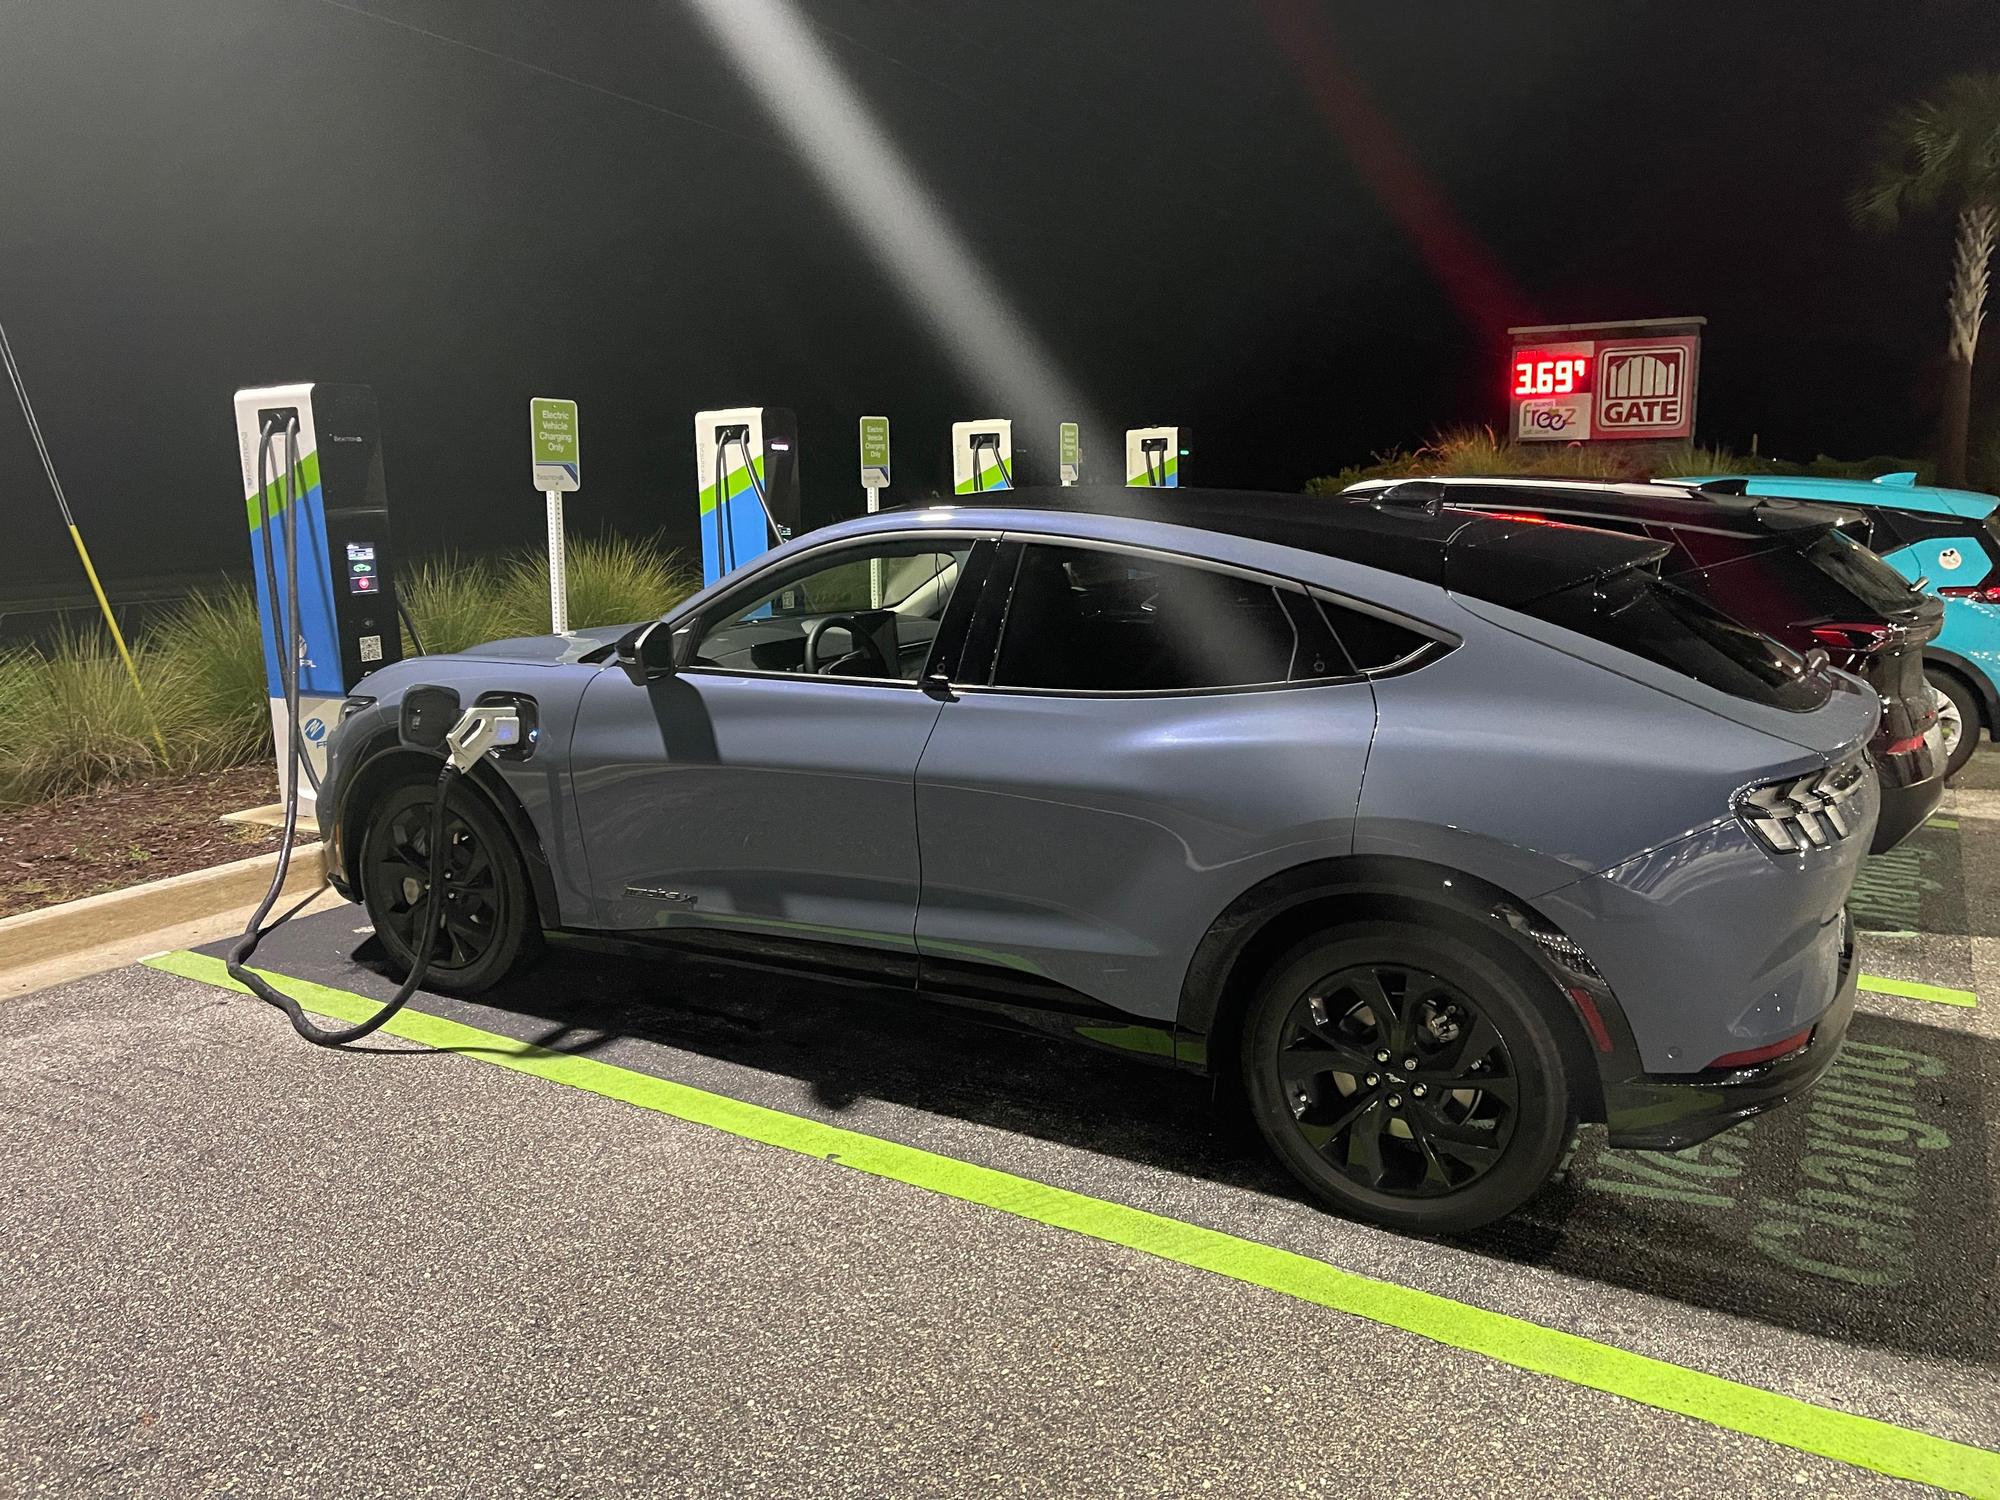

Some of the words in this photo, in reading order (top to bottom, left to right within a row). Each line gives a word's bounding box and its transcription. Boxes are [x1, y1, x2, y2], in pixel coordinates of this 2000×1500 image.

[542, 410, 569, 420] Electric
[1604, 400, 1678, 423] GATE
[543, 421, 569, 431] Vehicle
[539, 431, 572, 443] Charging
[548, 442, 565, 453] Only
